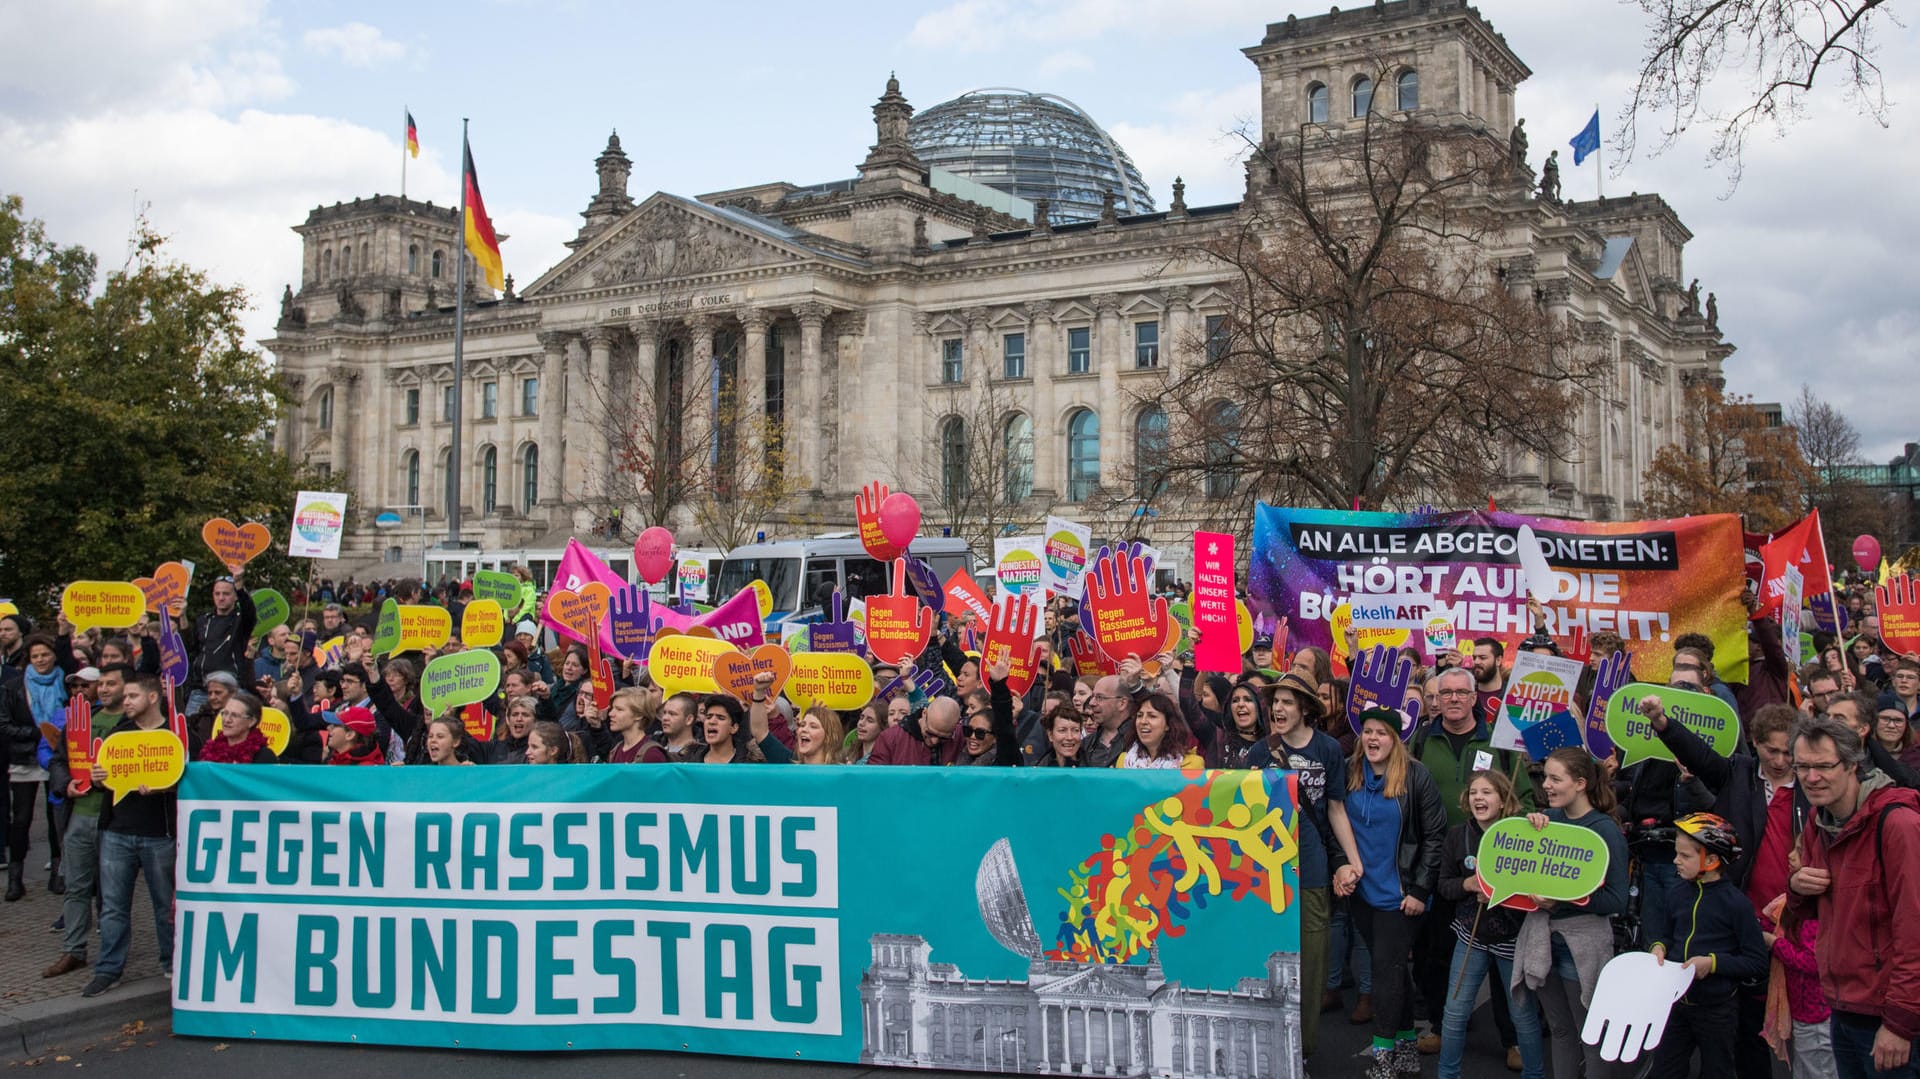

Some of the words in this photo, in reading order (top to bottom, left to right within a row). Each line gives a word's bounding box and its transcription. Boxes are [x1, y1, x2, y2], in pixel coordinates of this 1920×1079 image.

[611, 306, 631, 317] DEM
[701, 294, 731, 306] VOLKE
[217, 527, 236, 537] Mein
[238, 529, 255, 541] Herz
[215, 538, 243, 551] schlägt
[1299, 530, 1332, 553] AN
[1337, 532, 1407, 554] ALLE
[1413, 532, 1669, 562] ABGEODNETEN:
[1000, 559, 1040, 572] BUNDESTAG
[1205, 561, 1220, 571] WIR
[685, 575, 700, 584] AFD
[1002, 570, 1040, 583] NAZIFREI
[1198, 573, 1228, 585] HALTEN
[1336, 556, 1450, 594] HÖRT
[1550, 570, 1620, 605] DIE
[494, 580, 516, 591] Stimme
[1198, 587, 1228, 598] UNSERE
[70, 591, 97, 602] Meine
[100, 591, 136, 603] Stimme
[495, 591, 512, 600] Hetze
[561, 597, 579, 608] Mein
[580, 593, 597, 604] Herz
[75, 606, 102, 616] gegen
[105, 604, 130, 615] Hetze
[563, 606, 589, 619] schlägt
[590, 602, 601, 611] für
[870, 607, 893, 618] Gegen
[949, 586, 968, 600] DIE
[965, 595, 990, 625] LINK
[1199, 600, 1227, 611] WERTE
[401, 617, 415, 626] ine
[417, 616, 446, 627] Stimme
[479, 610, 497, 621] Stimme
[1098, 608, 1124, 621] Gegen
[1173, 610, 1190, 625] Mein
[1201, 613, 1227, 623] HOCH!
[1883, 613, 1904, 623] Gegen
[480, 623, 496, 633] Hetze
[615, 621, 633, 629] Gegen
[870, 619, 910, 629] Rassismus
[1100, 617, 1145, 632] Rassismus
[1426, 623, 1453, 632] STOPPT
[401, 629, 418, 640] gen
[420, 628, 442, 638] Hetze
[814, 632, 834, 641] Gegen
[870, 630, 879, 639] im
[880, 629, 920, 642] Bundestag
[1102, 633, 1113, 643] im
[1114, 626, 1157, 642] Bundestag
[1434, 630, 1448, 642] AFD
[814, 640, 849, 649] Rassismus
[660, 647, 692, 662] Meine
[695, 650, 718, 663] Stim
[427, 667, 452, 684] Meine
[454, 662, 489, 678] Stimme
[664, 664, 697, 679] gegen
[728, 661, 751, 674] Mein
[752, 659, 773, 670] Herz
[791, 665, 818, 679] Meine
[821, 666, 862, 680] Stimme
[1009, 665, 1030, 681] destag
[431, 682, 456, 699] gegen
[459, 676, 484, 689] Hetze
[730, 674, 754, 688] schlä
[796, 683, 825, 697] gegen
[828, 682, 857, 694] Hetze
[1354, 684, 1378, 700] Gegen
[1512, 680, 1566, 703] STOPPT
[1519, 700, 1553, 722] AFD
[1670, 705, 1726, 731] Stimme
[1626, 720, 1658, 741] geg
[106, 746, 135, 760] Meine
[137, 743, 174, 758] Stimme
[111, 762, 141, 778] gegen
[143, 759, 169, 772] Hetze
[186, 808, 387, 888] GEGEN
[414, 811, 818, 898] RASSISMUS
[1493, 831, 1535, 853] Meine
[1537, 837, 1594, 863] Stimme
[1495, 855, 1537, 876] gegen
[1540, 857, 1581, 880] Hetze
[178, 910, 260, 1003] IM
[294, 914, 823, 1025] BUNDESTAG
